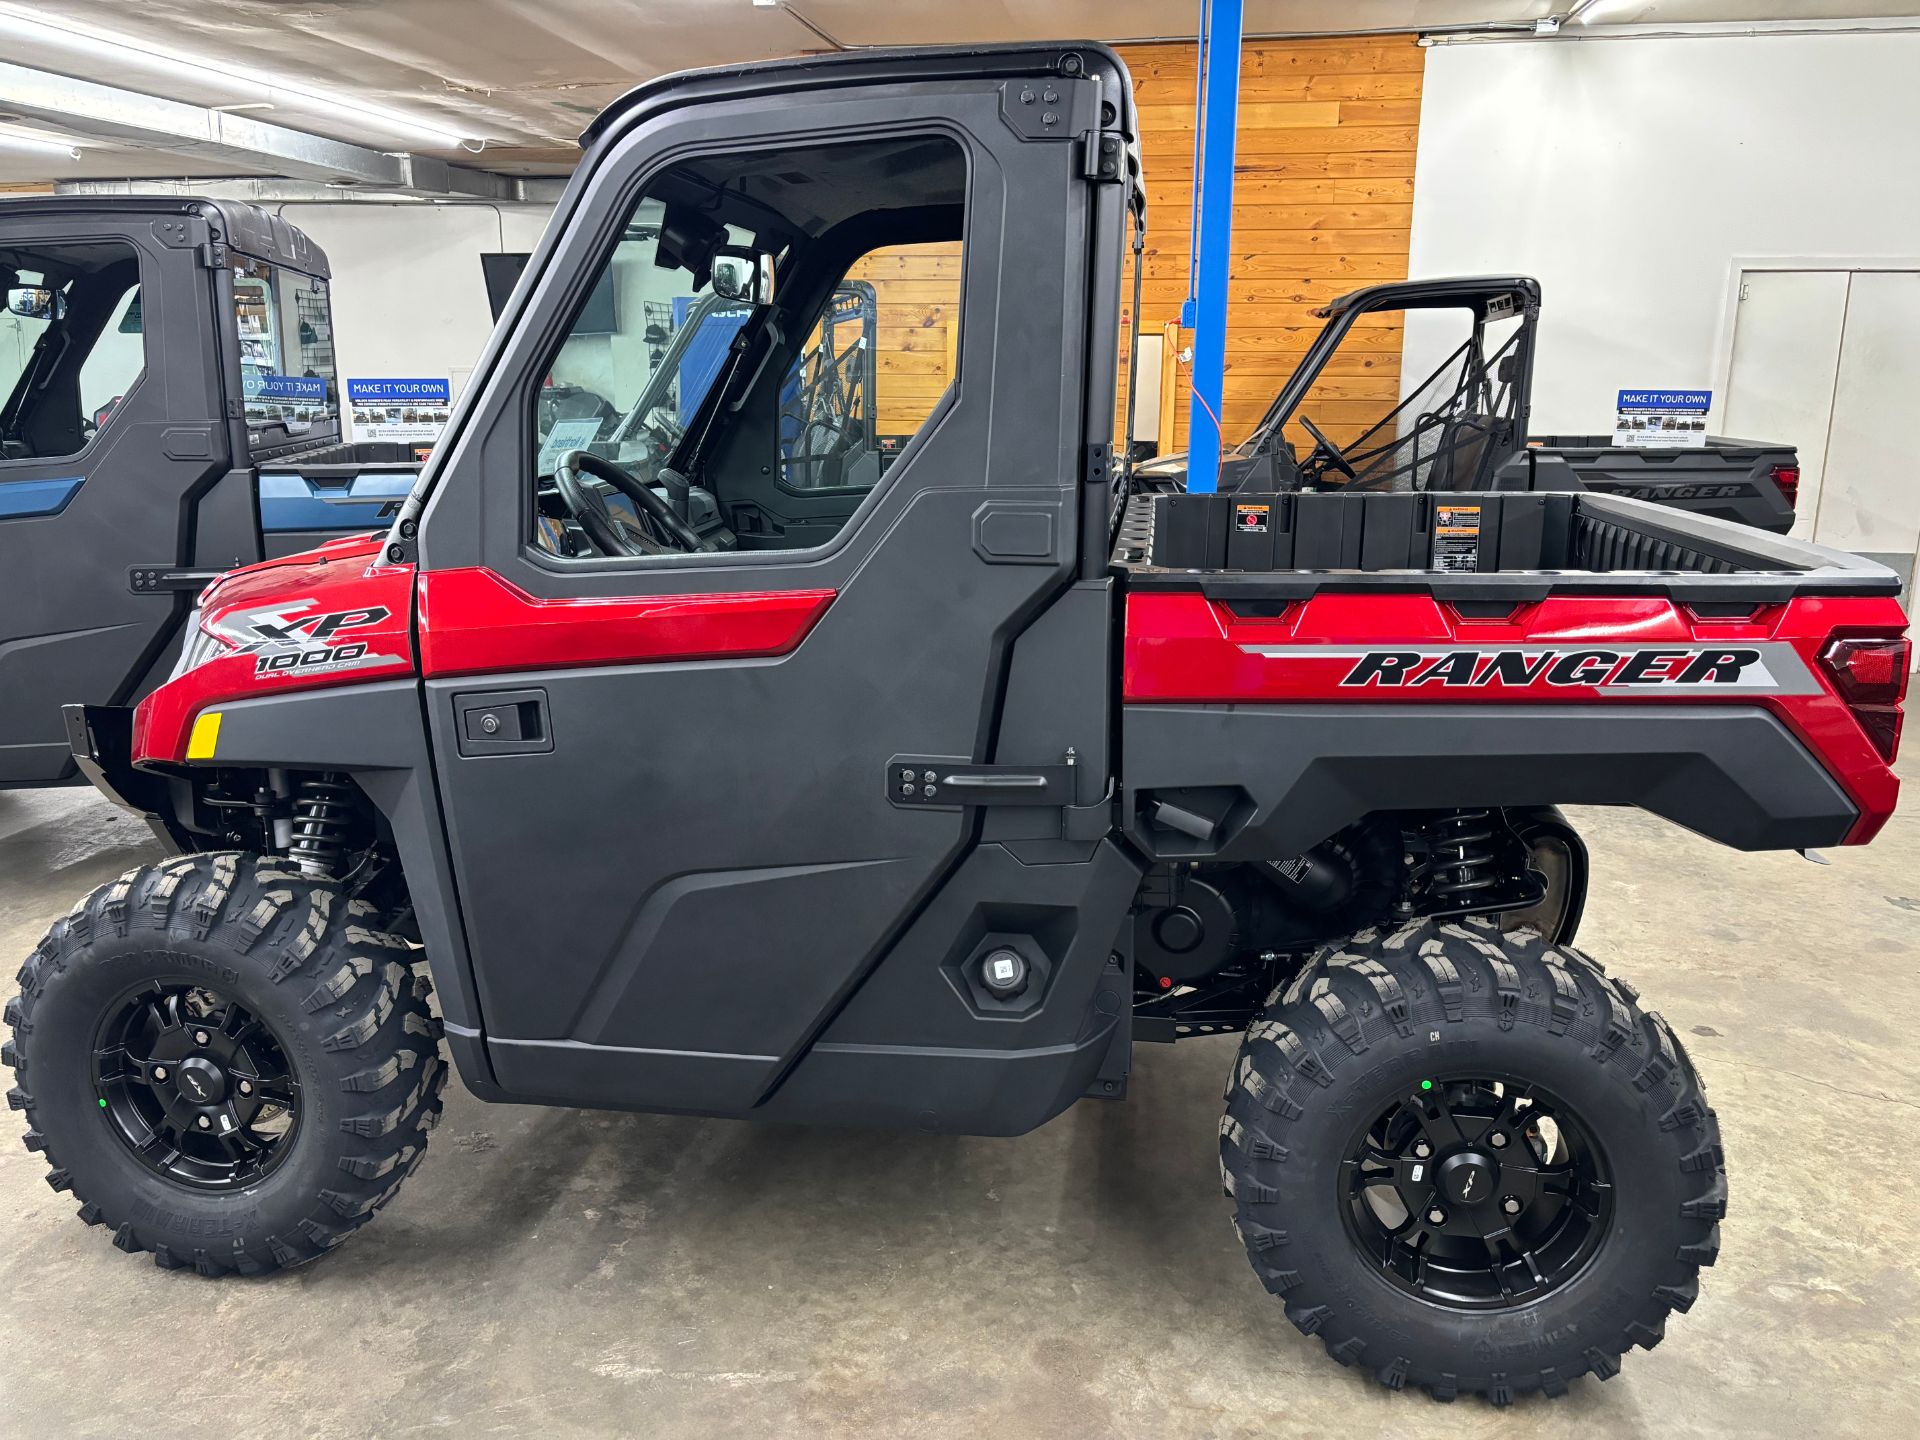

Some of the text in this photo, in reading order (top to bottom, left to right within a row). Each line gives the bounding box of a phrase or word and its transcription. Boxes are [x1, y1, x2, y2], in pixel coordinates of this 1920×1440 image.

[353, 384, 444, 393] MAKE IT YOUR OWN
[1623, 394, 1707, 404] MAKE IT YOUR OWN
[229, 605, 392, 655] XP
[254, 641, 368, 674] 1000
[1338, 649, 1761, 687] RANGER
[254, 660, 361, 681] DUAL OVERHEAD CAM
[1429, 1031, 1440, 1042] CH
[1462, 1170, 1476, 1199] XP
